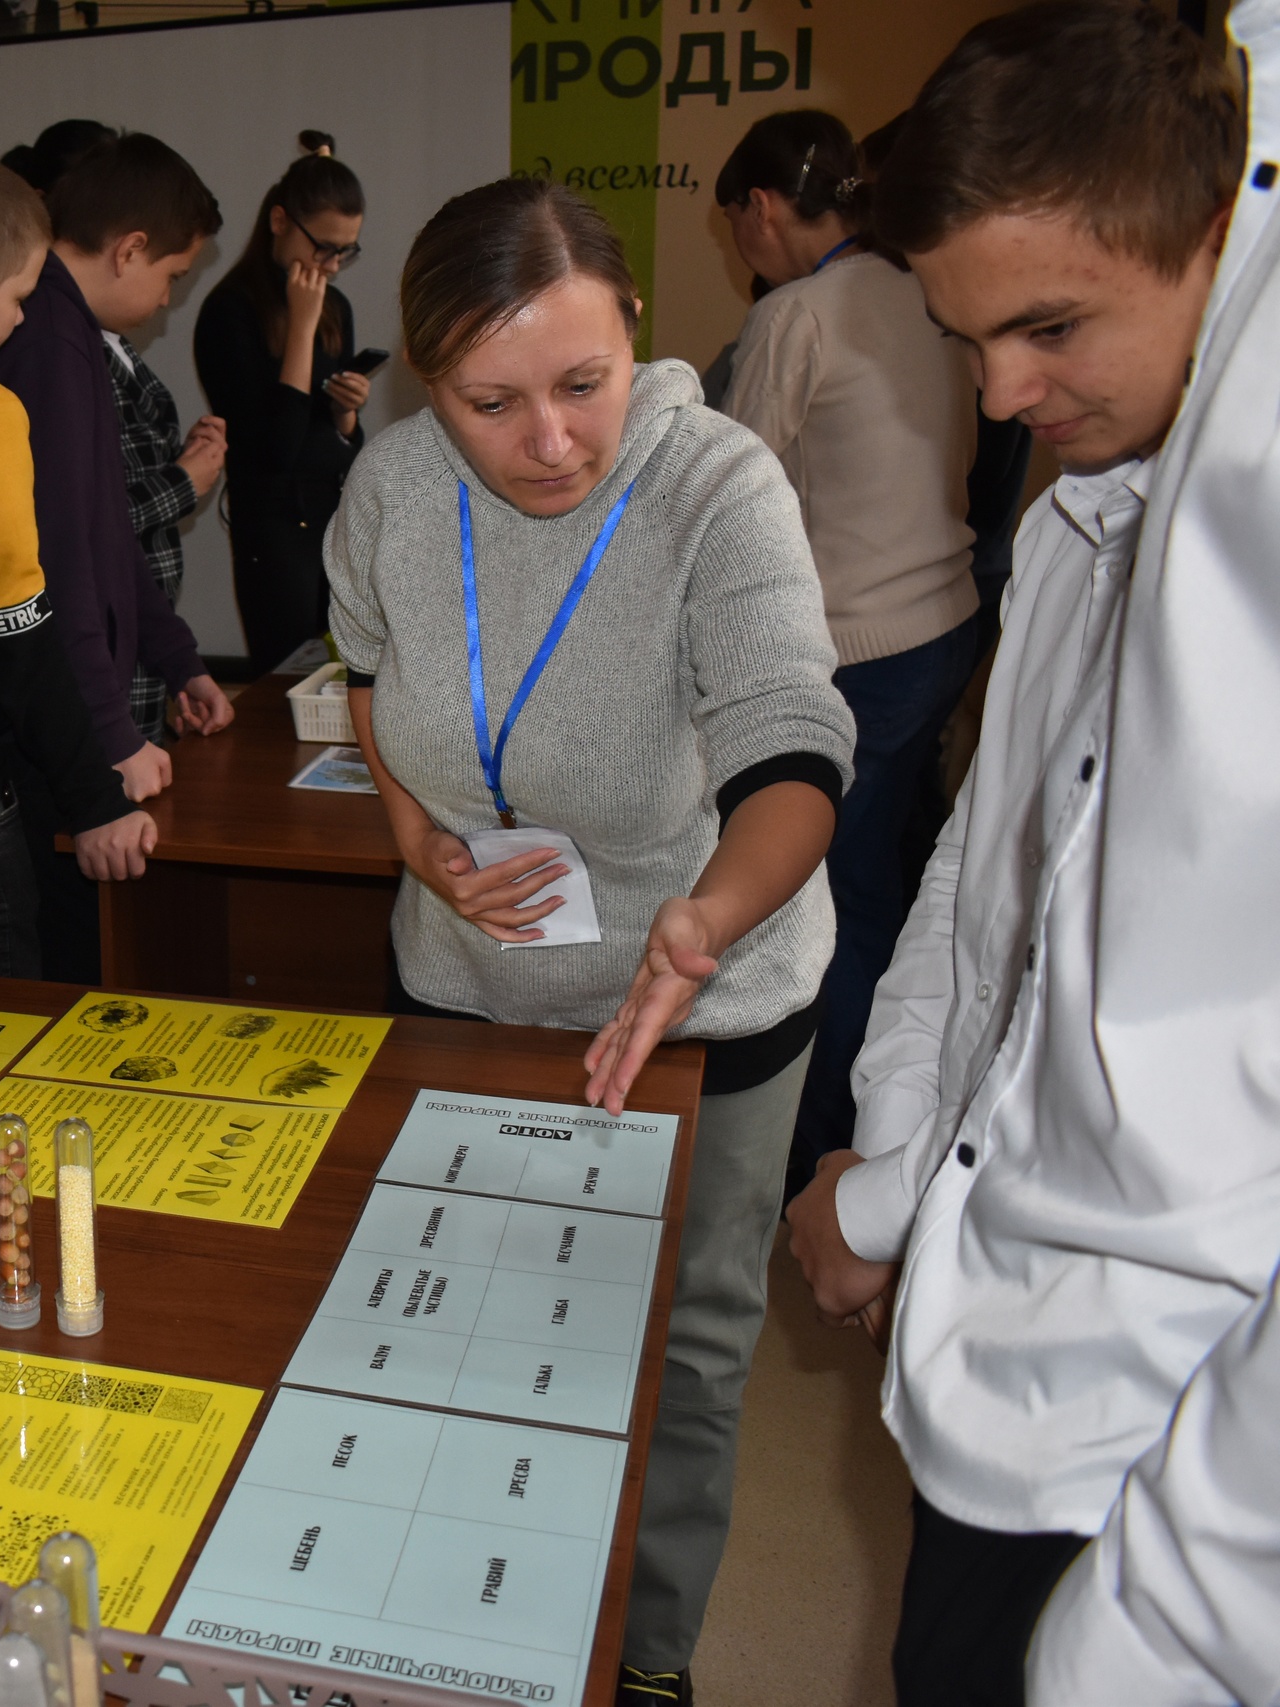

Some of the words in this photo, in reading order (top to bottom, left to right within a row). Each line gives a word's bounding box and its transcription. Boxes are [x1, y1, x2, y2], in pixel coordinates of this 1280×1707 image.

[426, 1101, 511, 1118] ПОРОДЫ
[518, 1112, 658, 1133] ОБЛОМОЧНЫЕ
[498, 1124, 572, 1140] ЛОТО
[444, 1144, 470, 1184] КОНГЛОМЕРАТ
[583, 1167, 600, 1194] БРЕКЧИЯ
[419, 1206, 445, 1249] ДРЕСВЯНИК
[557, 1225, 577, 1263] ПЕСЧАНИК
[367, 1268, 393, 1309] АЛЕВРИТЫ
[402, 1269, 432, 1318] (ПЫЛЕВАТЫЕ
[423, 1275, 450, 1315] ЧАСТИЦЫ)
[551, 1298, 570, 1325] ГЛЫБА
[370, 1344, 392, 1370] ВАЛУН
[533, 1364, 553, 1395] ГАЛЬКА
[332, 1434, 357, 1468] ПЕСОК
[508, 1458, 532, 1499] ДРЕСВА
[290, 1525, 321, 1572] ЩЕБЕНЬ
[480, 1558, 507, 1604] ГРАВИЙ
[186, 1619, 321, 1658] ПОРОДЫ
[330, 1644, 555, 1702] ОБЛОМОЧНЫЕ
